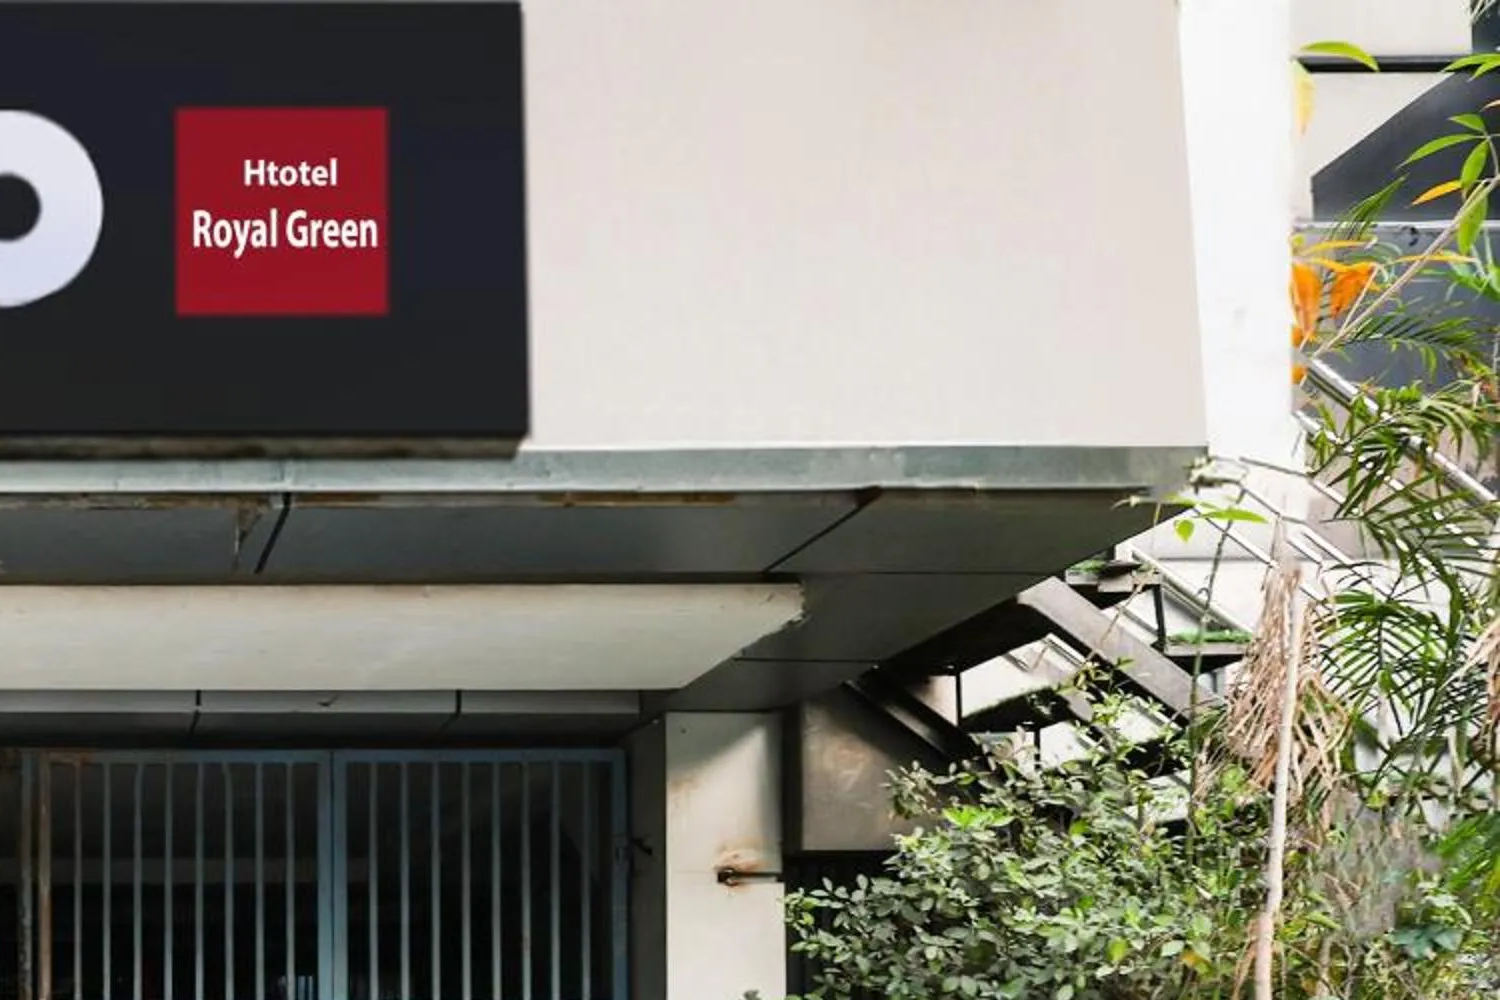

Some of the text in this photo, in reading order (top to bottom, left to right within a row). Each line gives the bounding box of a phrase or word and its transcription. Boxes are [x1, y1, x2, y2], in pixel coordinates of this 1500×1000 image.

[243, 158, 338, 187] Htotel
[192, 208, 378, 259] Royal Green
